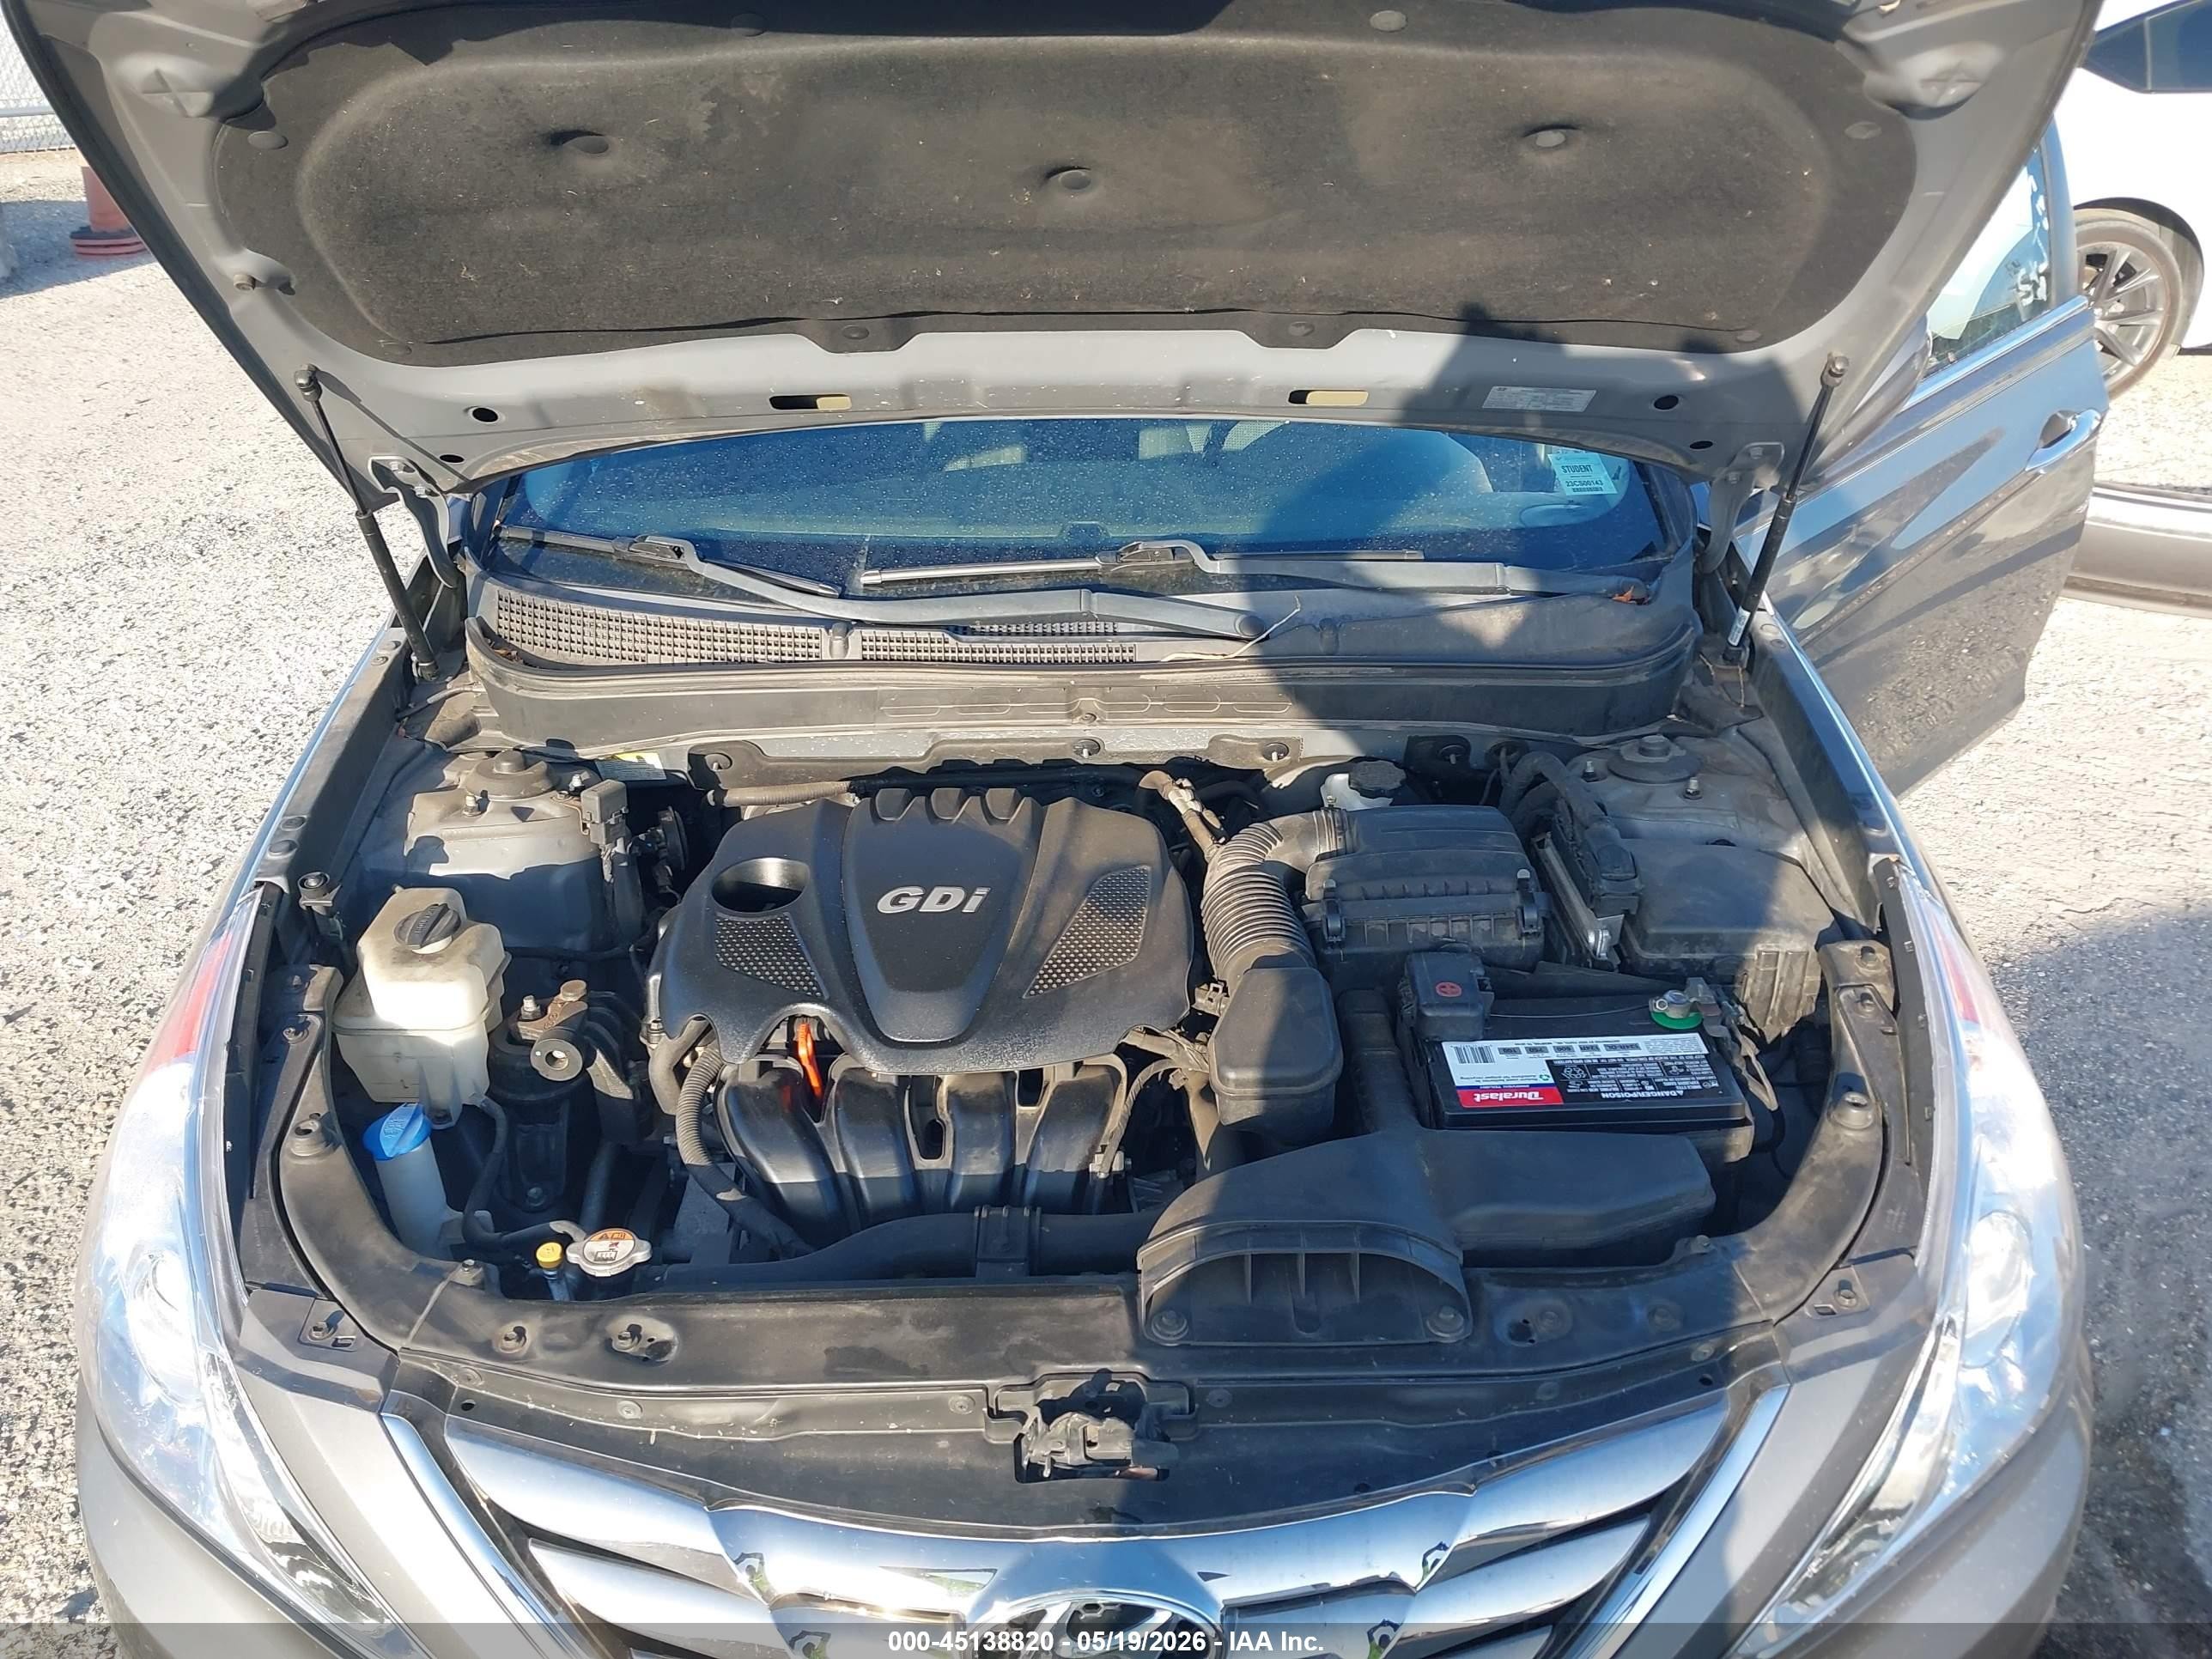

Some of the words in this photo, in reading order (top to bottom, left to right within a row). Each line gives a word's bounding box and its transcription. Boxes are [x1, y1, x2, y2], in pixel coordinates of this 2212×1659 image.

[1561, 465, 1593, 473] STUDENT
[877, 885, 992, 915] GDi
[1474, 1091, 1544, 1102] Duralast
